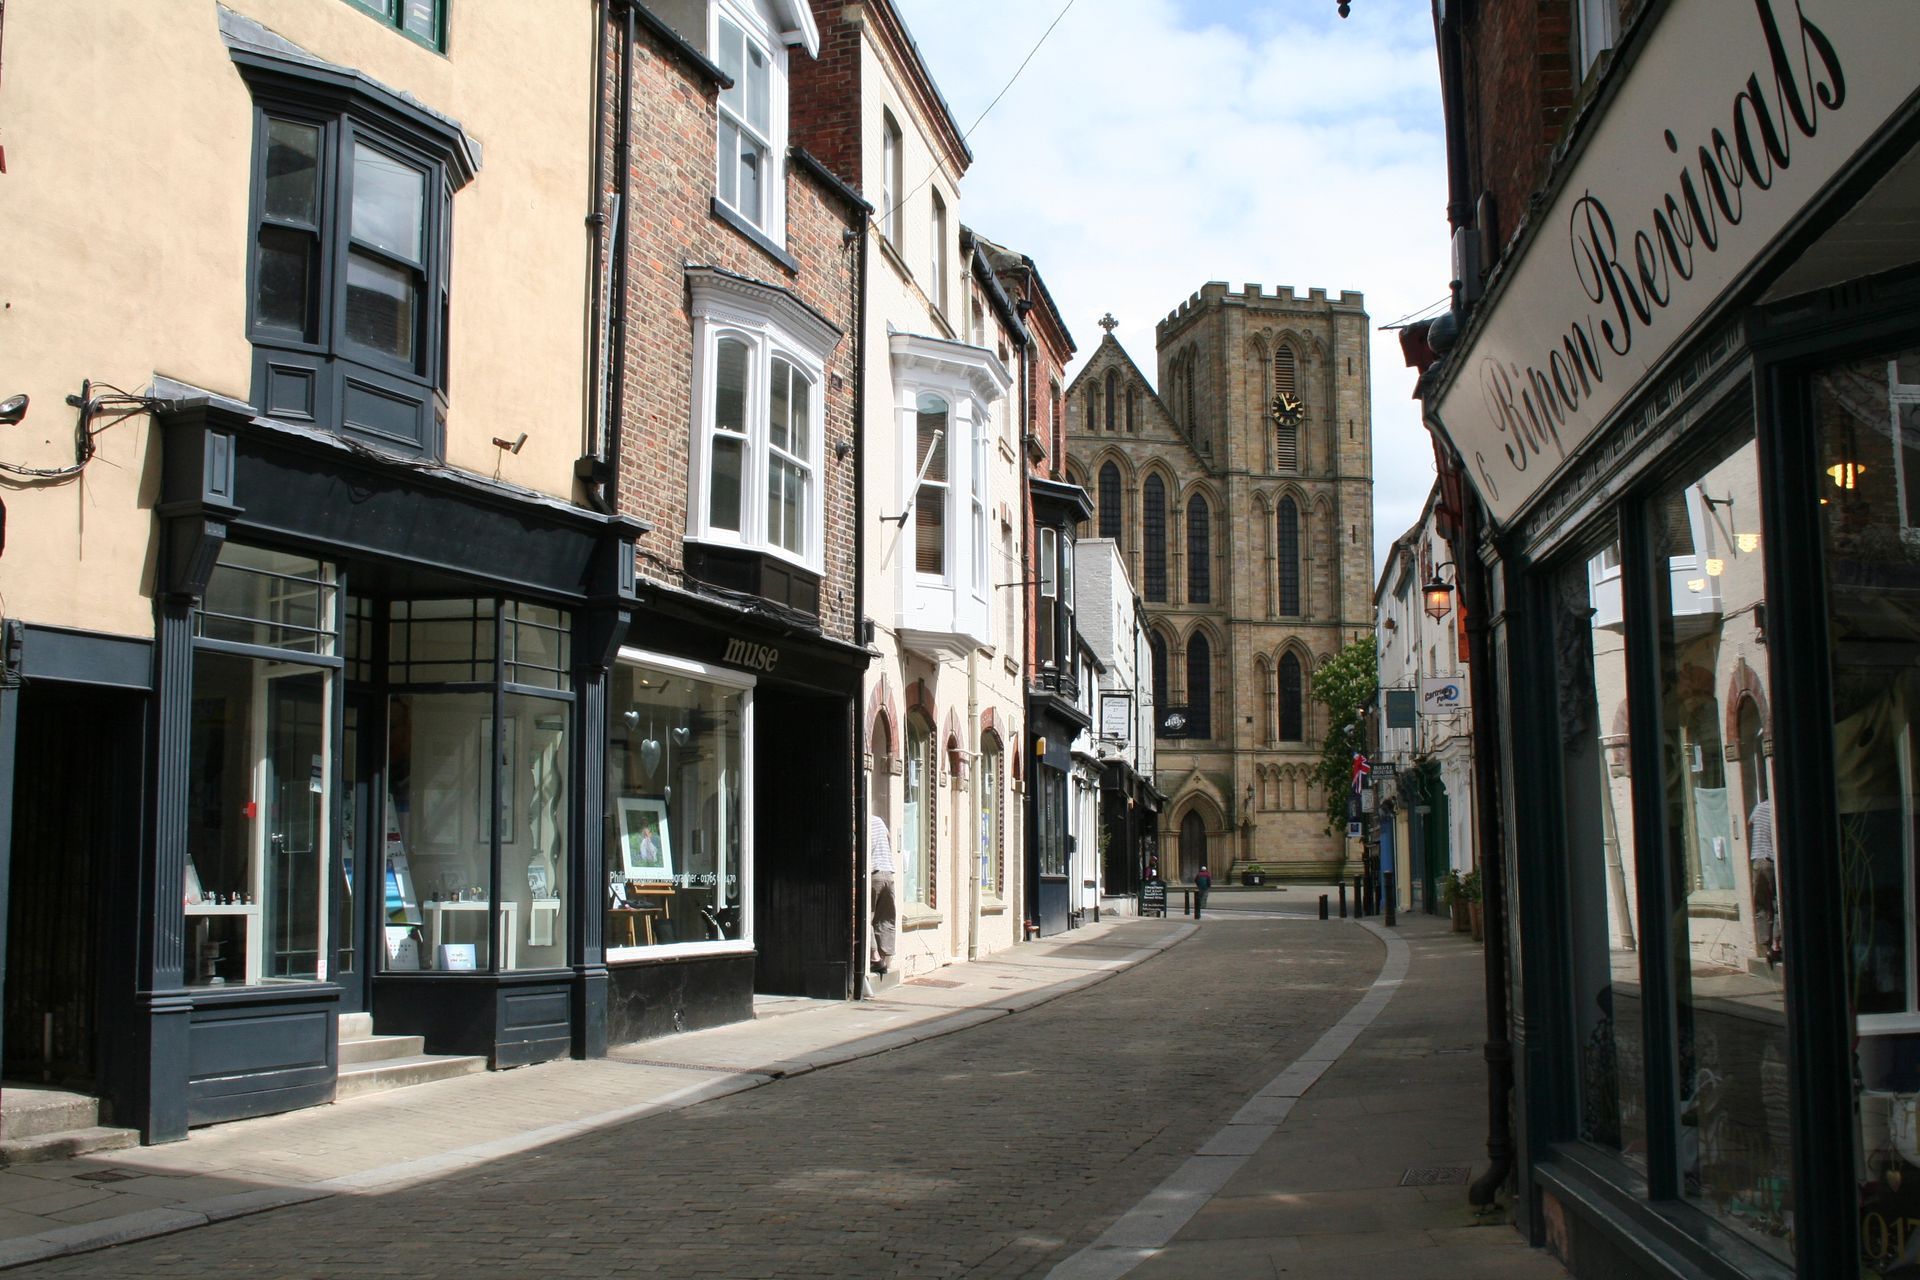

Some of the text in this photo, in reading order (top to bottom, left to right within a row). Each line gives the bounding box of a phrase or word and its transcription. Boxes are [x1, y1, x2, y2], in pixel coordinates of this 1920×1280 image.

[1476, 0, 1846, 501] 6 Ripon Revivals
[722, 638, 779, 672] muse
[700, 871, 716, 886] 01765
